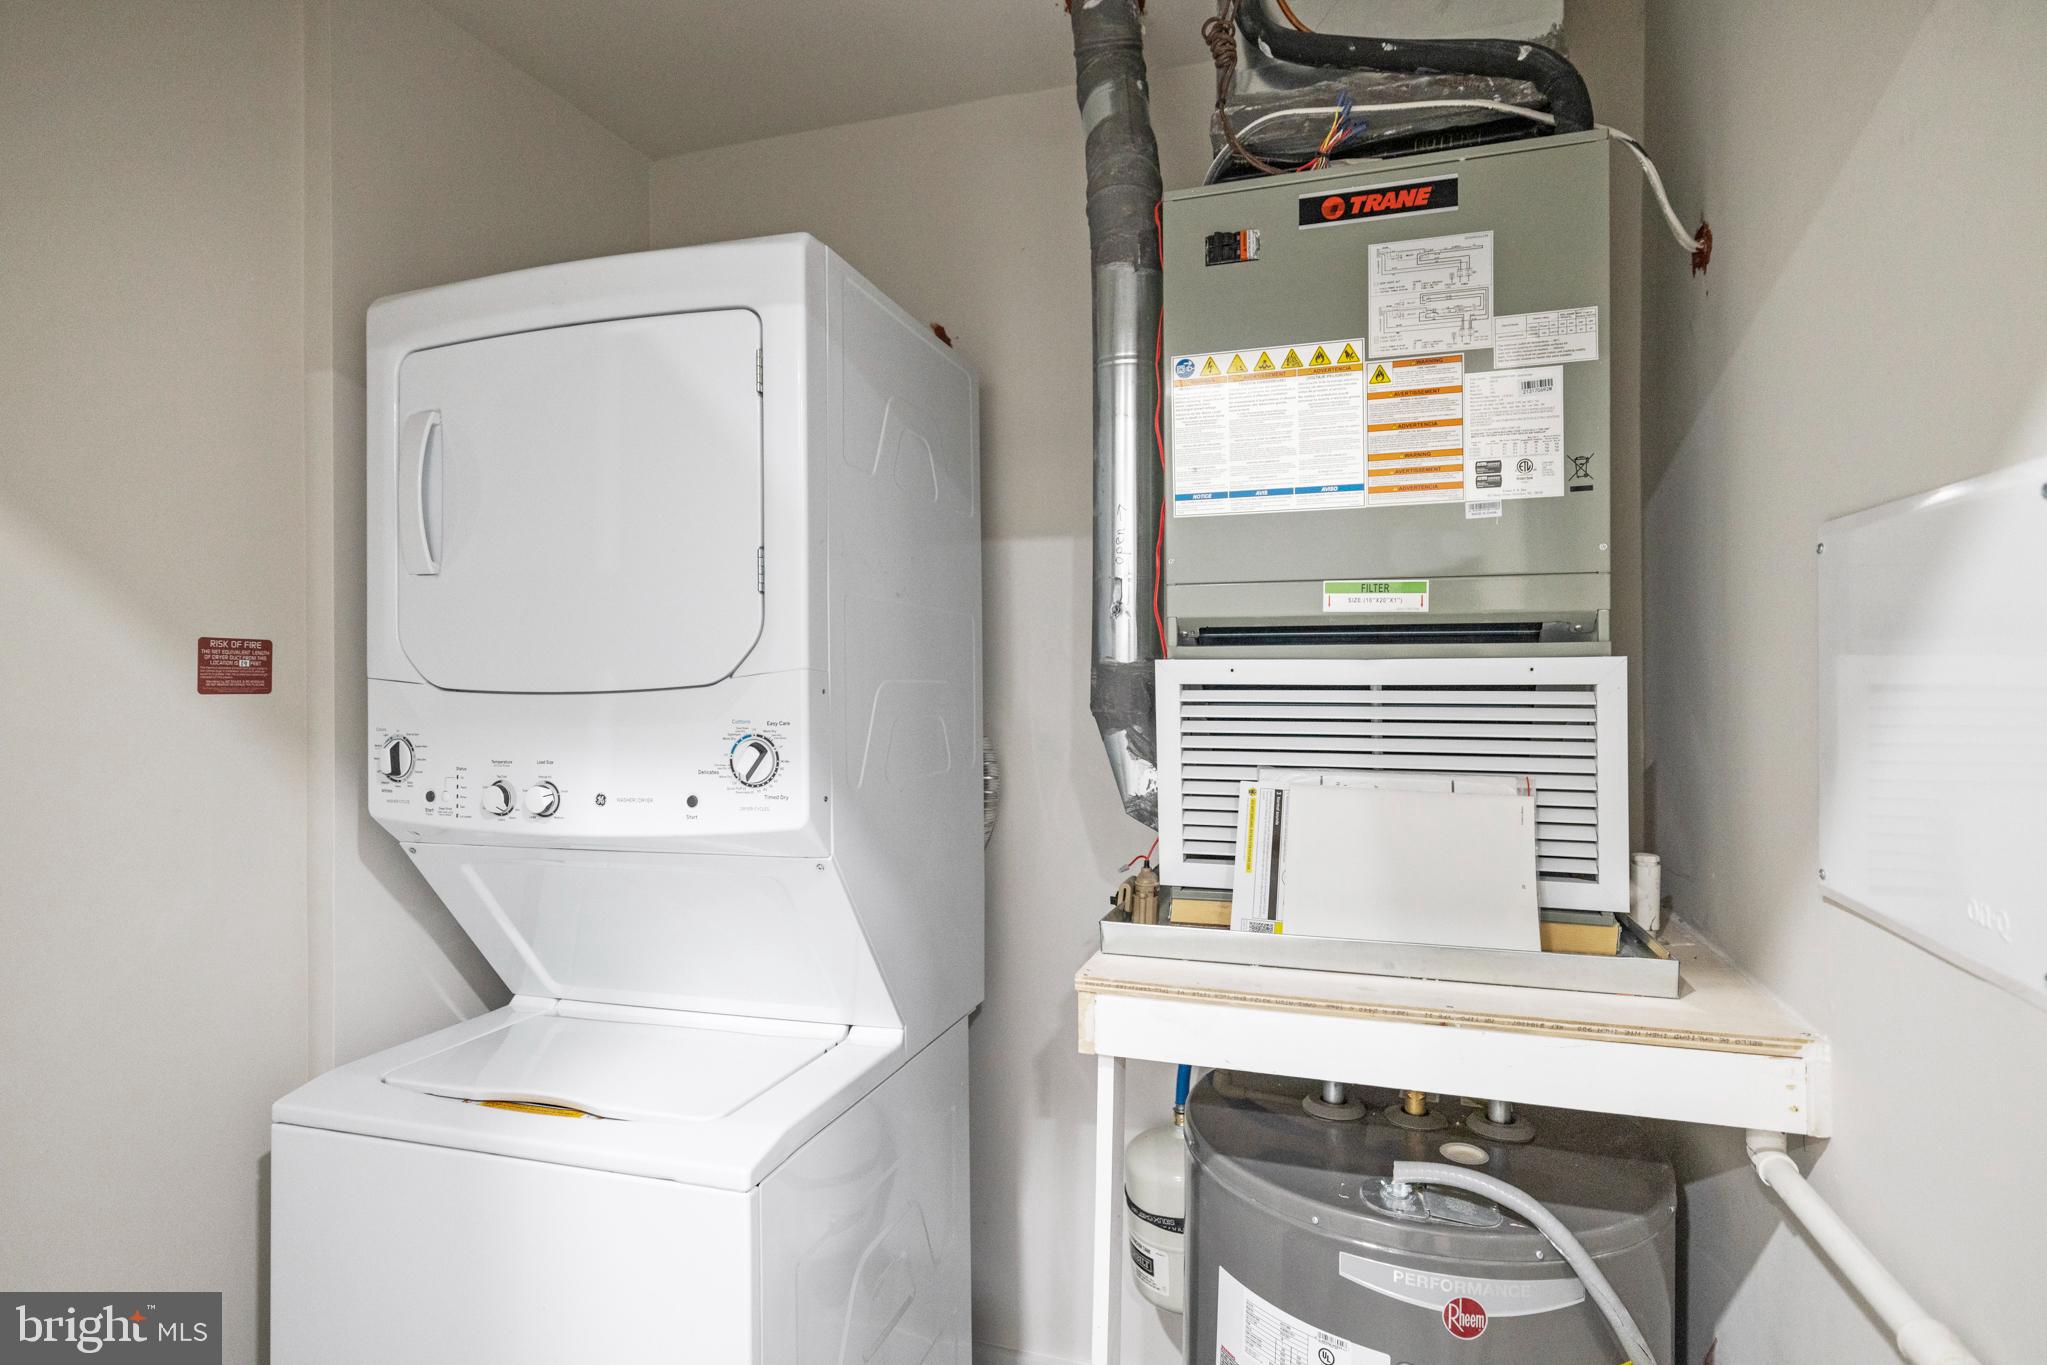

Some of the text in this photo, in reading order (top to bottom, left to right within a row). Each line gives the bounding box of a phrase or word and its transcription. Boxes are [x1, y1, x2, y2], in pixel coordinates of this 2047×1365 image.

[1351, 186, 1433, 215] TRANE
[1393, 388, 1441, 398] AVERTISSEMENT
[1397, 421, 1438, 430] ADVERTENCIA
[1404, 451, 1432, 459] WARNING
[1394, 466, 1441, 475] AVERTISSEMENT
[1398, 484, 1439, 492] ADVERTENCIA
[1192, 492, 1213, 500] NOTICE
[1360, 583, 1390, 593] FILTER
[209, 639, 262, 650] RISK OF FIRE
[1393, 1269, 1531, 1298] PERFORMANCE
[1448, 1302, 1486, 1332] Rheem
